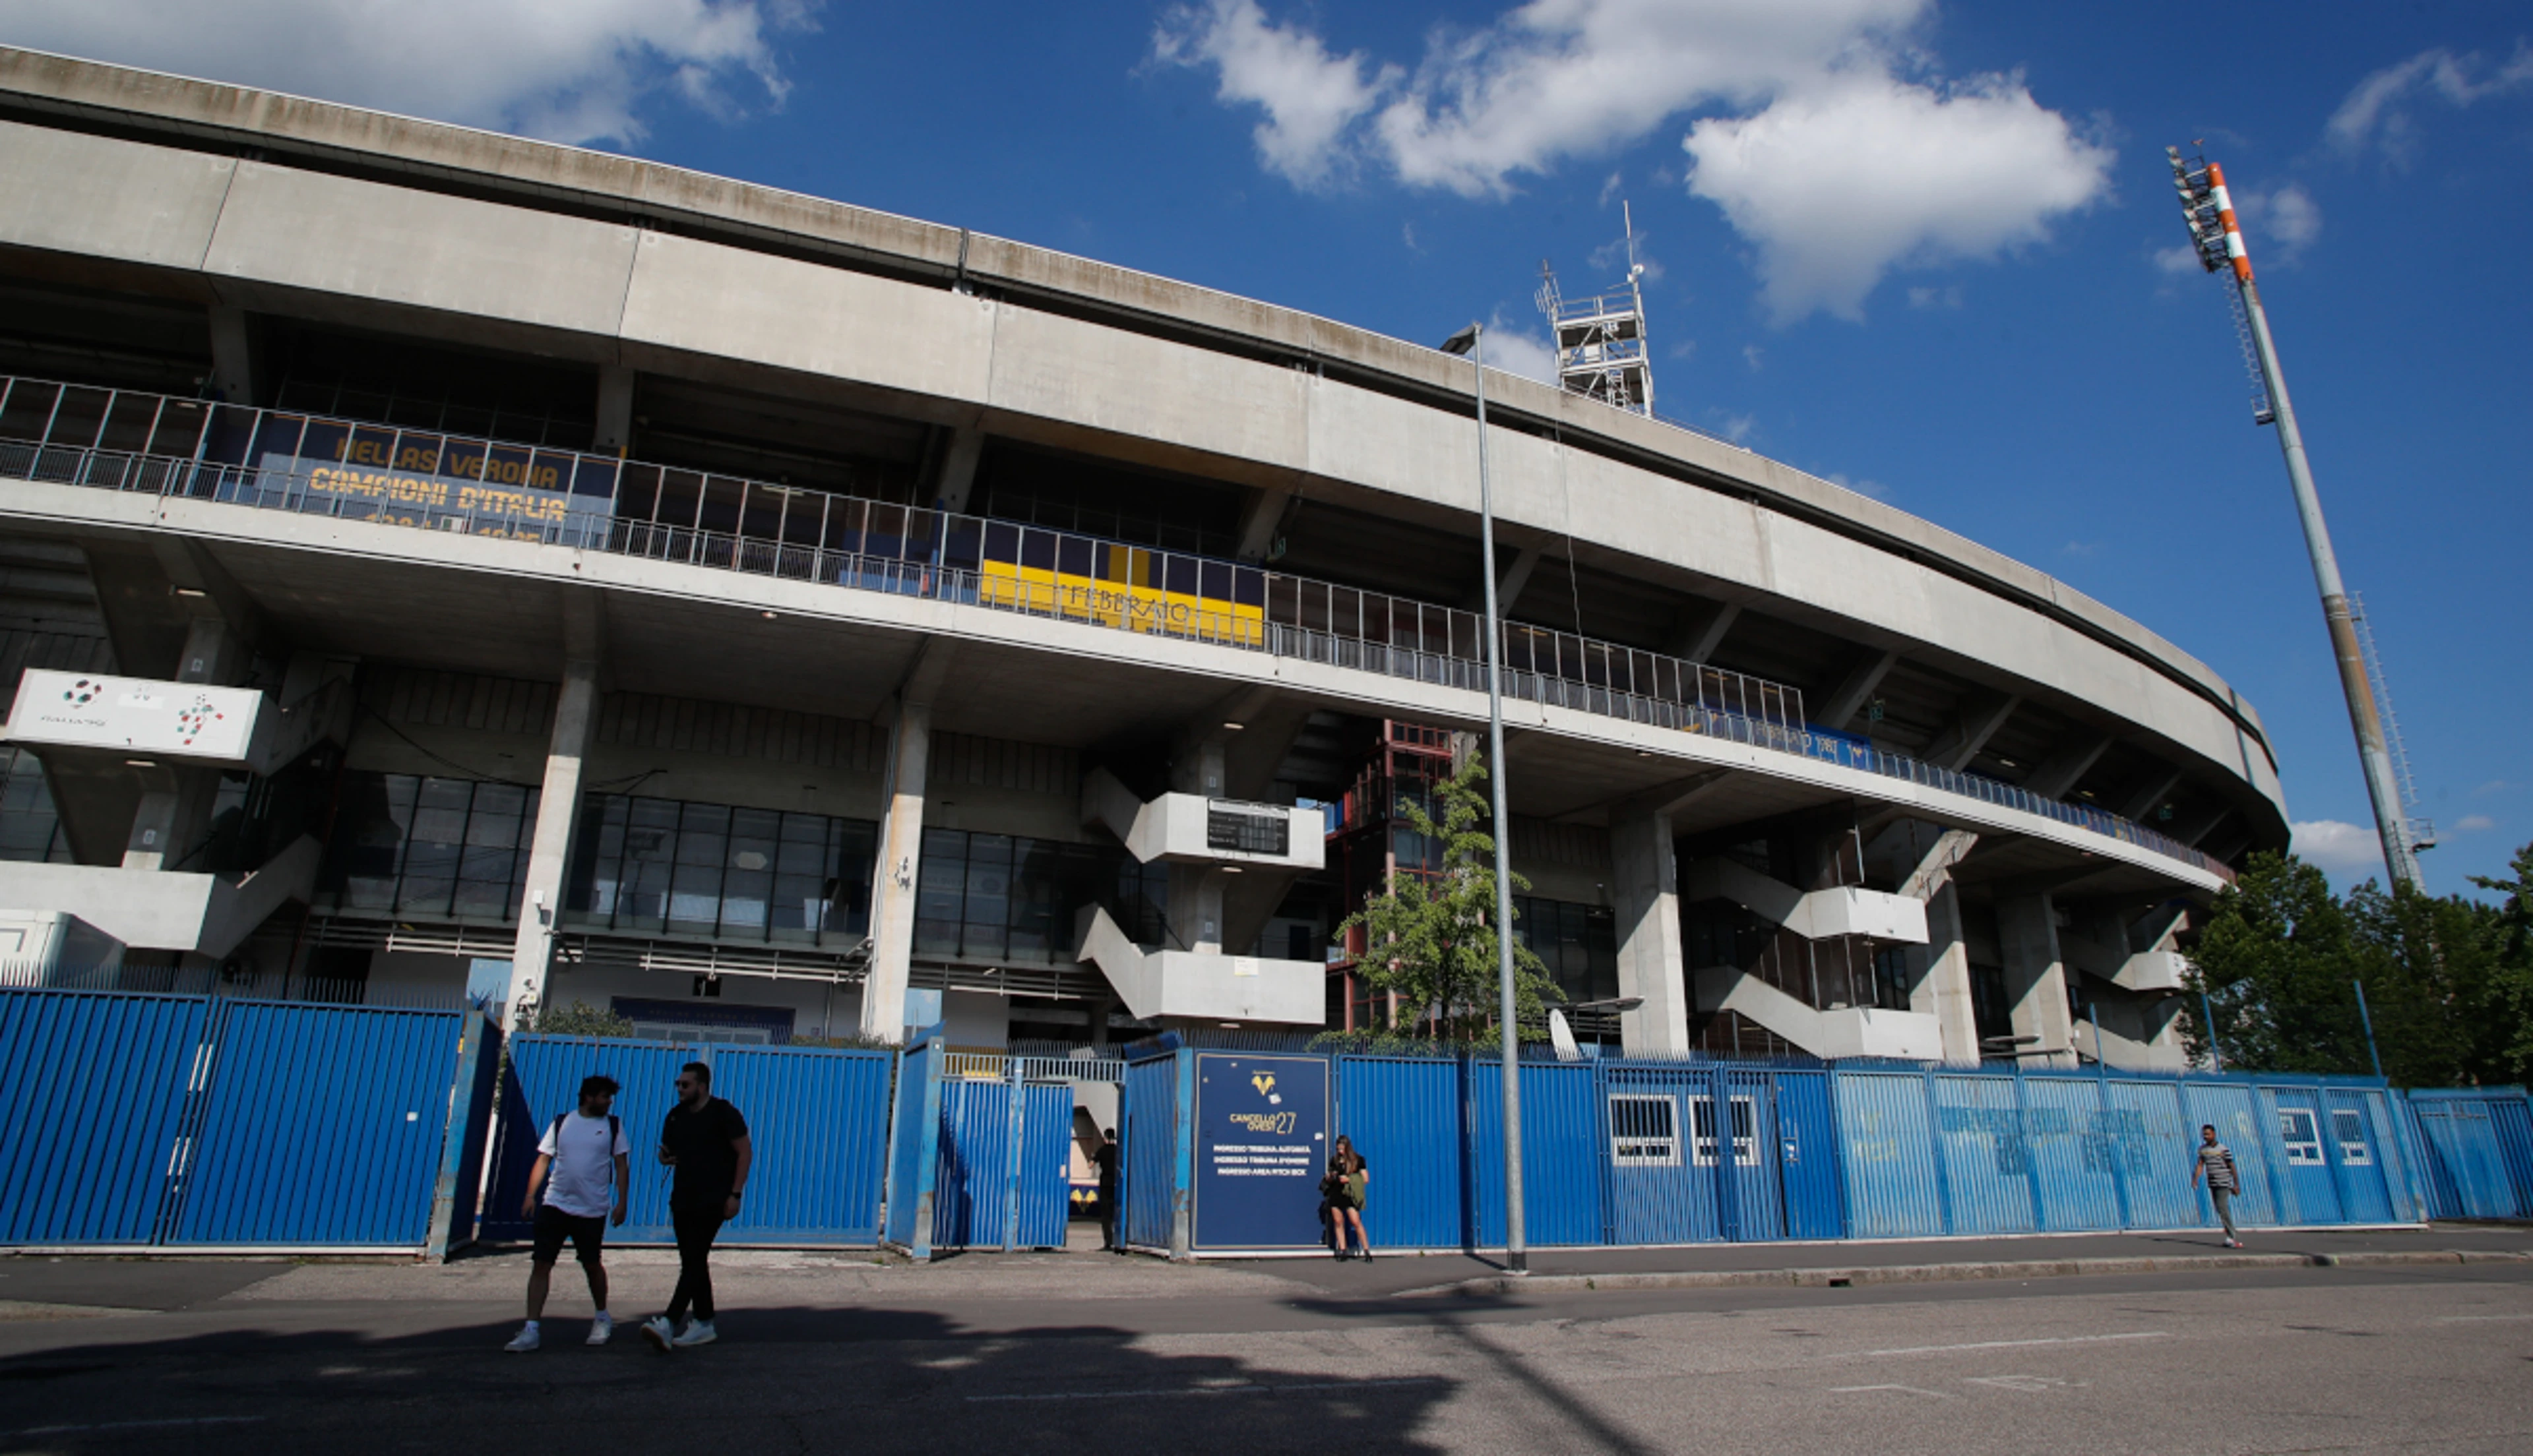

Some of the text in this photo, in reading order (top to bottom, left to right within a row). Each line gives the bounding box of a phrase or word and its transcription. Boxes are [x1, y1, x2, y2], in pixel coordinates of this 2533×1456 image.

[334, 437, 559, 489] HELLAS VERONA
[309, 467, 450, 506] CAMPIONI
[456, 485, 566, 522] D'ITALIA
[1069, 584, 1190, 622] FEBBRAIO
[1276, 1112, 1297, 1135] 27
